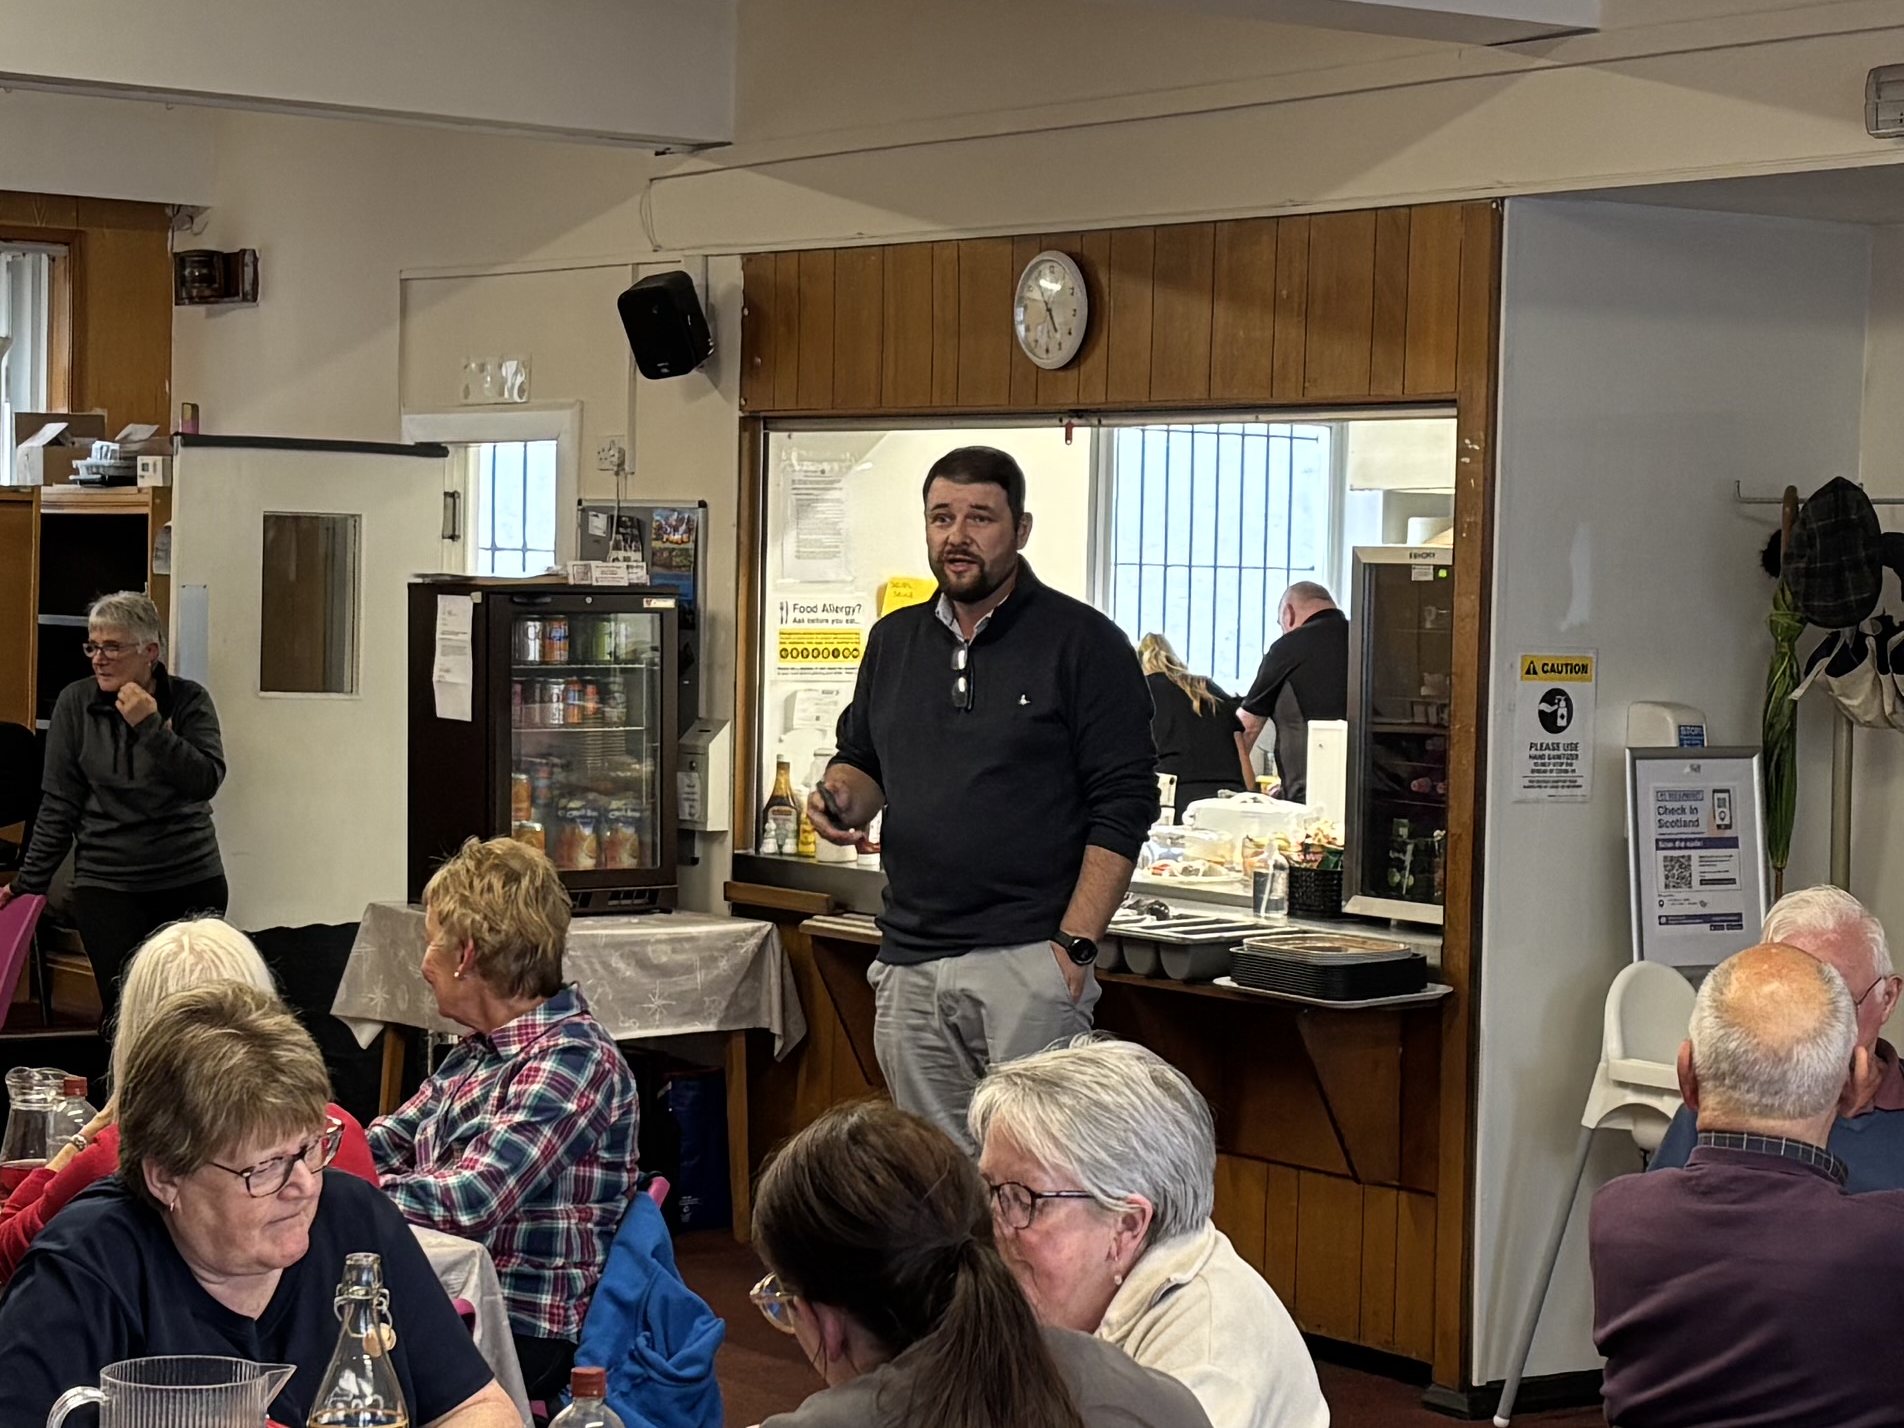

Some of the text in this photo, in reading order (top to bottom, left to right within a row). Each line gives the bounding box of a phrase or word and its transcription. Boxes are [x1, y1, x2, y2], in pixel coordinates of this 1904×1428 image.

[792, 603, 862, 616] Food Allergy?
[1541, 663, 1589, 675] CAUTION
[1529, 742, 1579, 752] PLEASE USE
[1657, 805, 1688, 816] Check
[1657, 817, 1700, 829] Scotland
